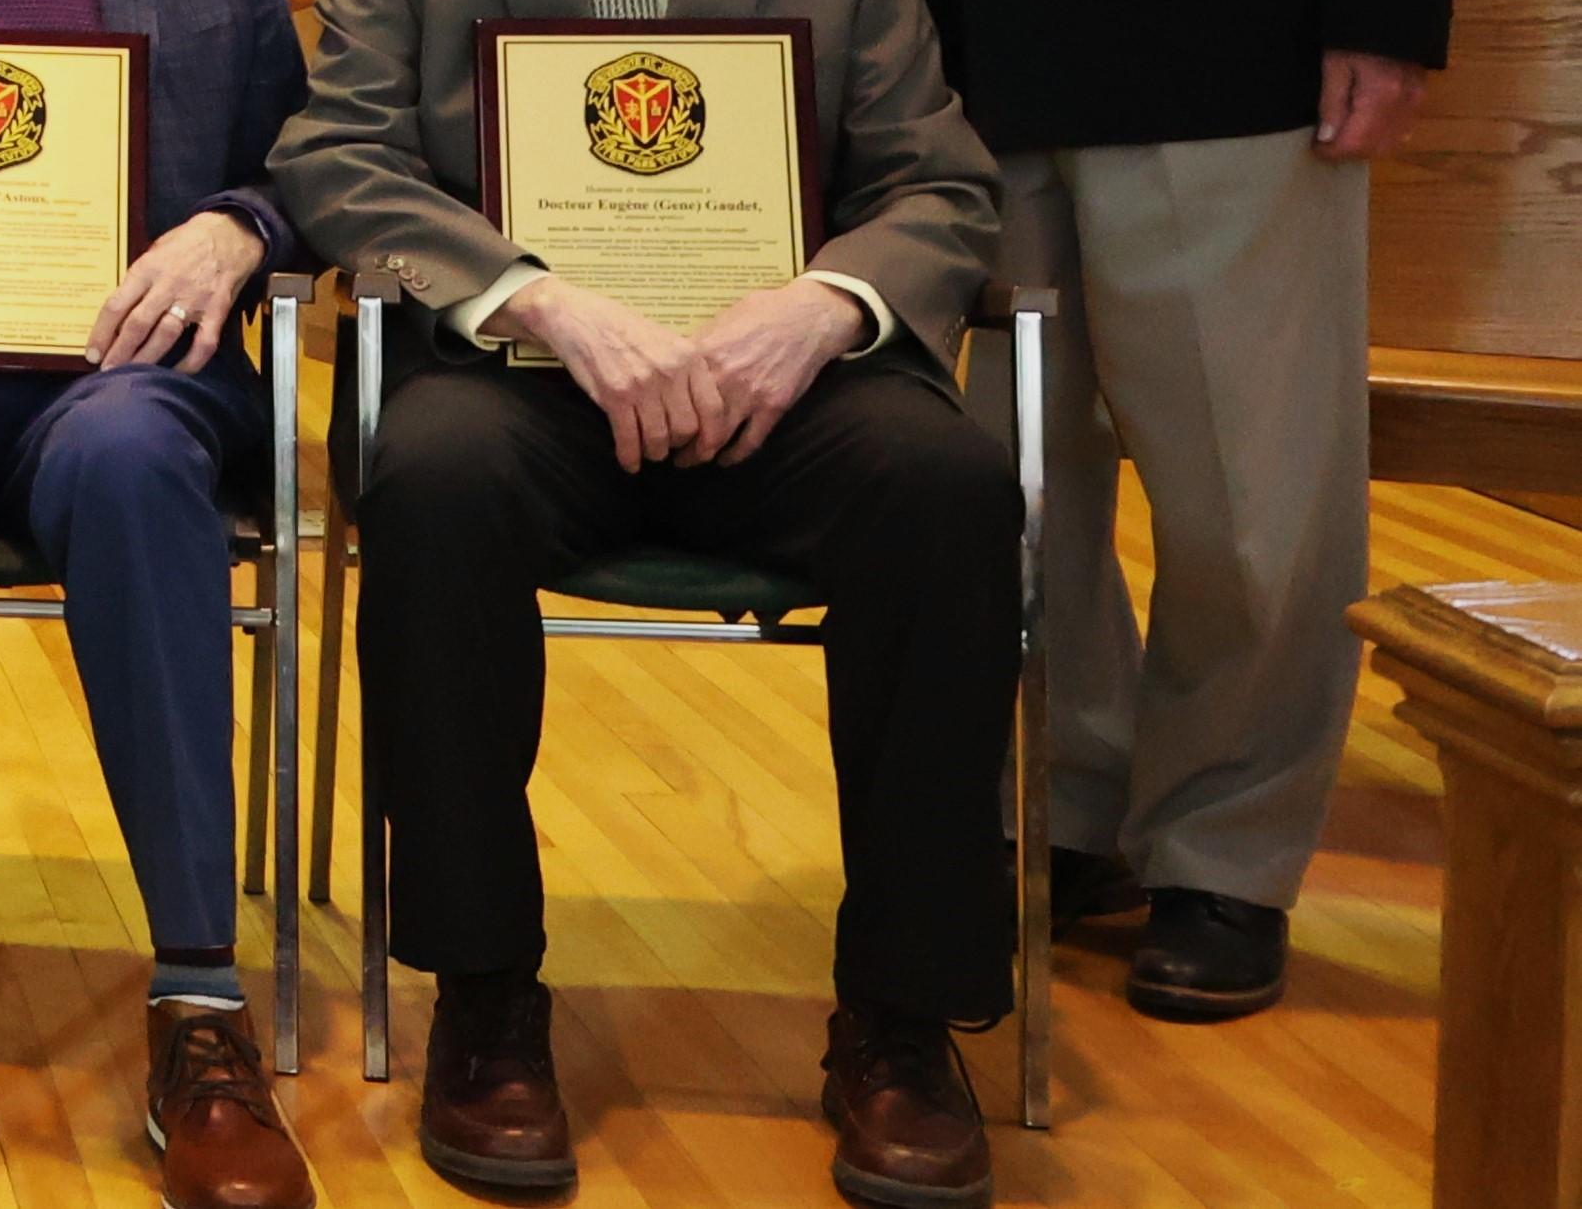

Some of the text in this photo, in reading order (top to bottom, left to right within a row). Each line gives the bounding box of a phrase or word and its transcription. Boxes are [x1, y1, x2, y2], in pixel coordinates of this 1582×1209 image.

[538, 198, 763, 213] Docteur Eugène (Gene) Gaudet,
